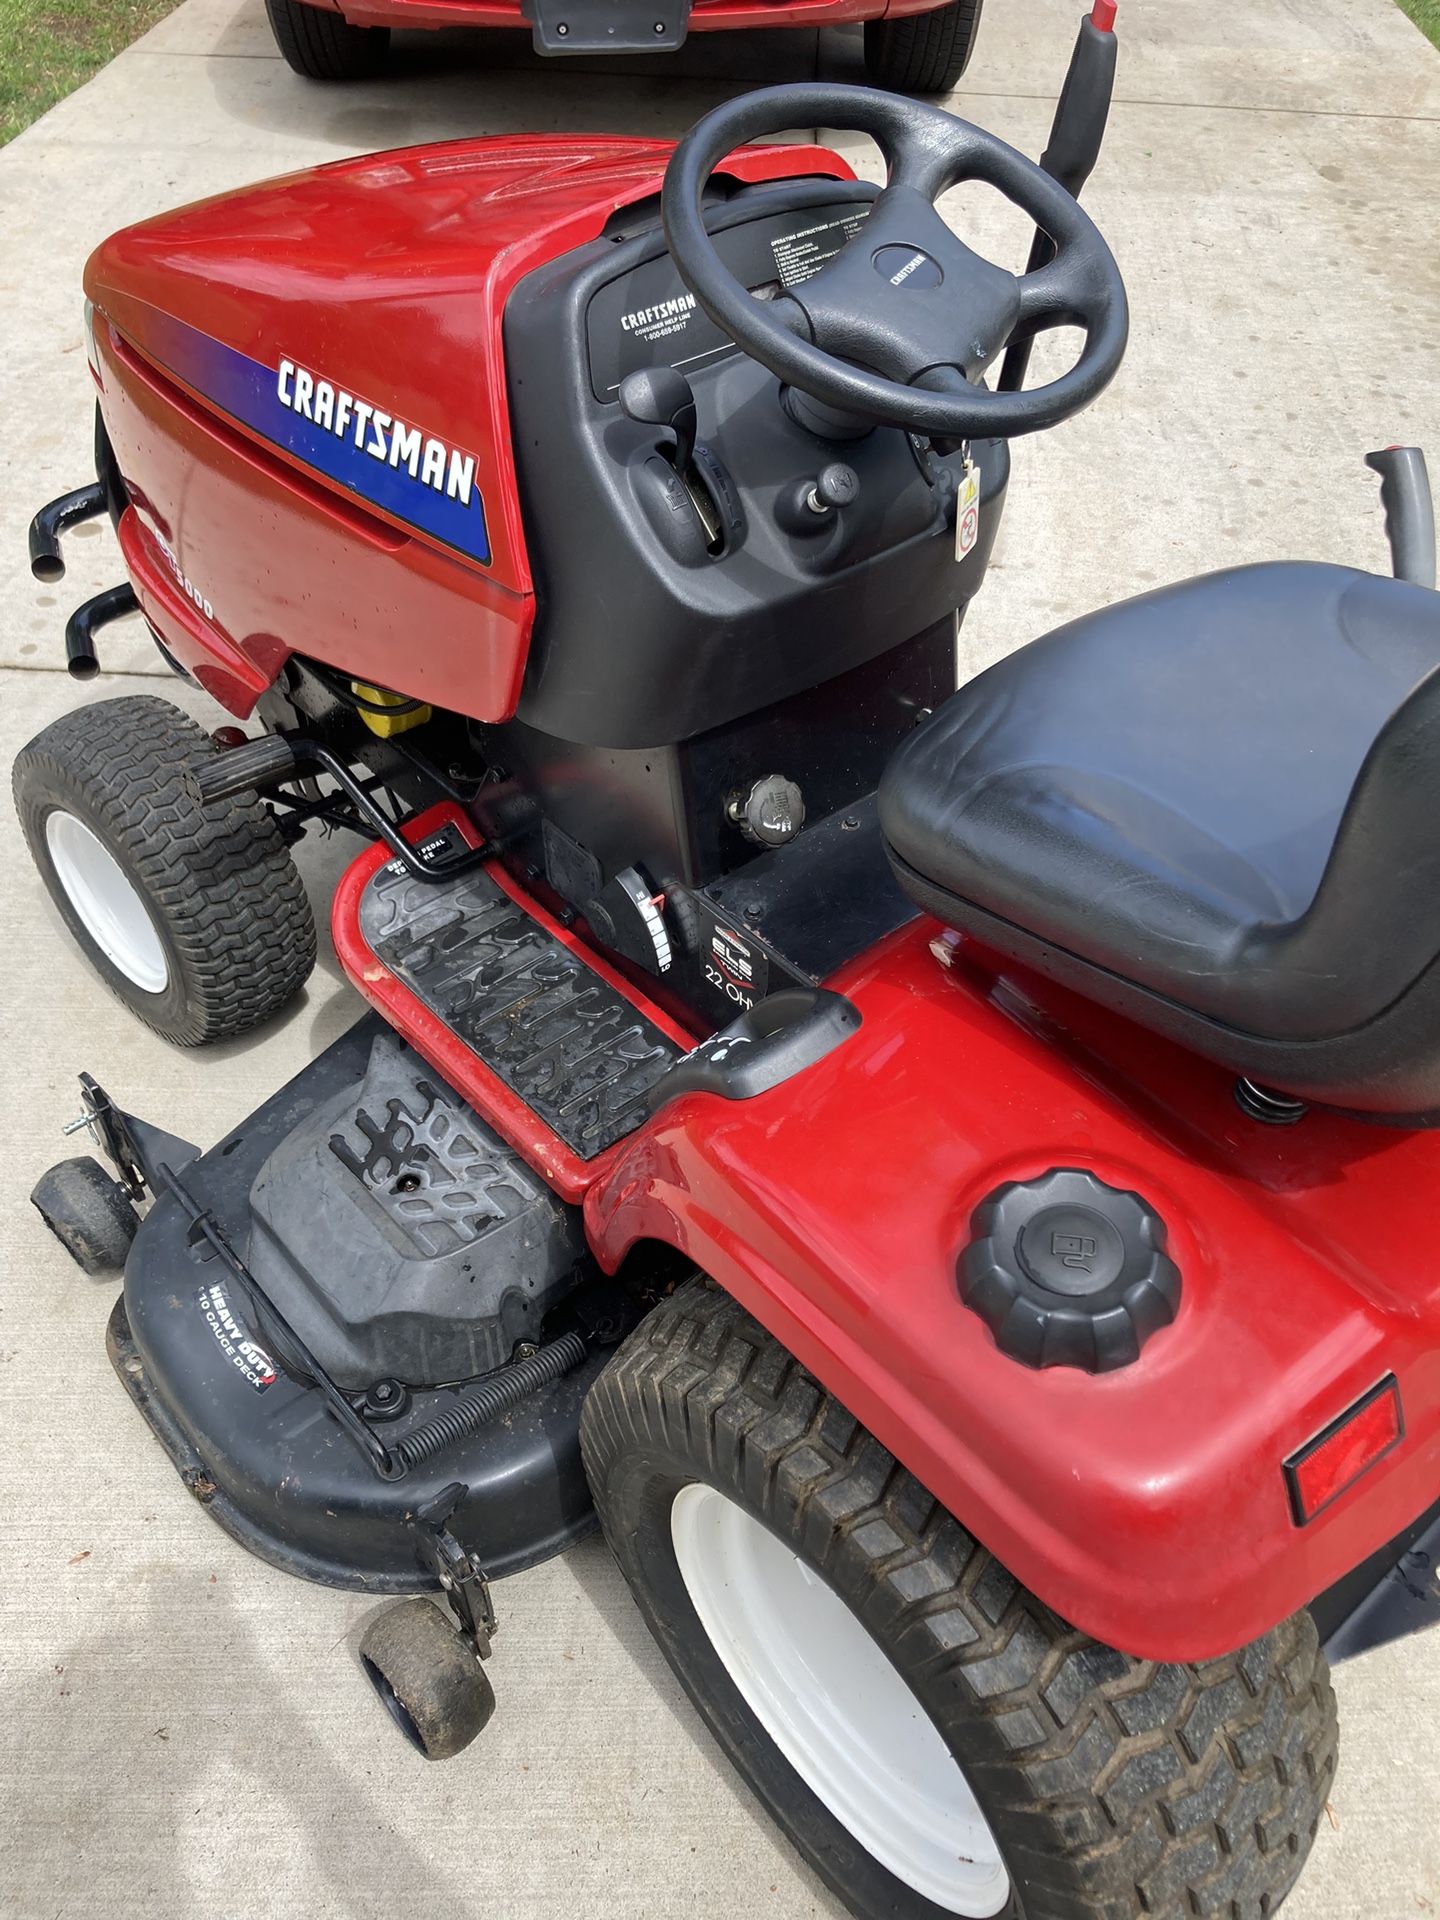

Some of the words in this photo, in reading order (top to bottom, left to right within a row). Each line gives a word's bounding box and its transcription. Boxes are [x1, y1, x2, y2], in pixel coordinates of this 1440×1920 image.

[889, 253, 927, 286] CRAFTSMAN
[620, 293, 697, 331] CRAFTSMAN
[634, 321, 665, 336] CONSUMER
[664, 317, 678, 327] HELP
[678, 312, 691, 321] LINE
[277, 359, 475, 506] CRAFTSMAN
[421, 838, 446, 854] PEDAL
[635, 890, 646, 900] HI
[661, 963, 671, 973] LO
[705, 964, 723, 990] 22
[199, 1292, 210, 1310] 10
[206, 1311, 236, 1357] GAUGE
[233, 1356, 264, 1388] DECK
[209, 1285, 243, 1340] HEAVY
[237, 1341, 274, 1378] DUTY
